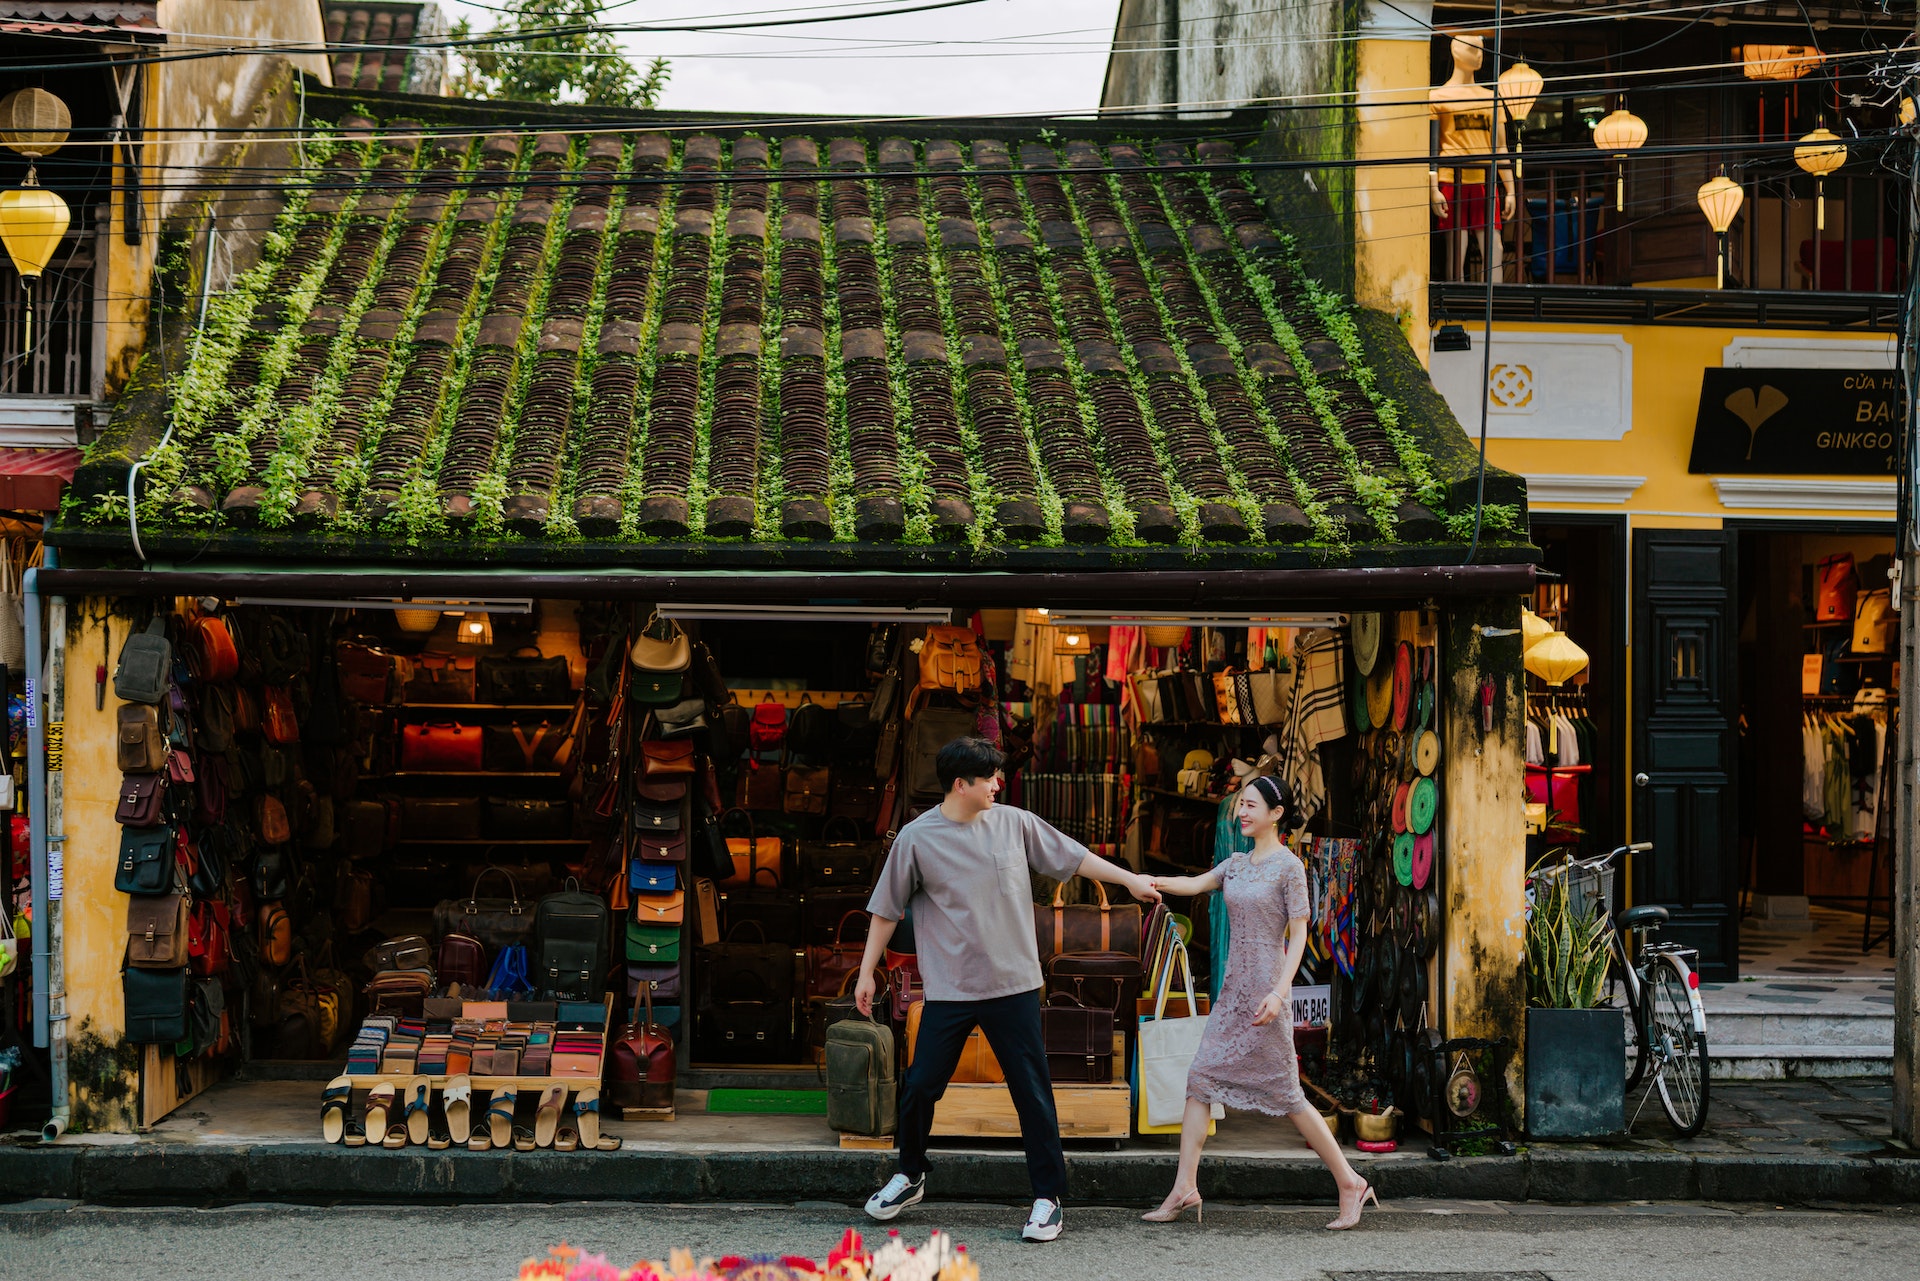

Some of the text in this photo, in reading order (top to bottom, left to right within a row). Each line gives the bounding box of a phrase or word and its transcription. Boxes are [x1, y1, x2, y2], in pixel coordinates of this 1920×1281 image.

[1843, 373, 1876, 390] CỬA
[1817, 431, 1892, 449] GINKGO
[1311, 998, 1327, 1021] BAG
